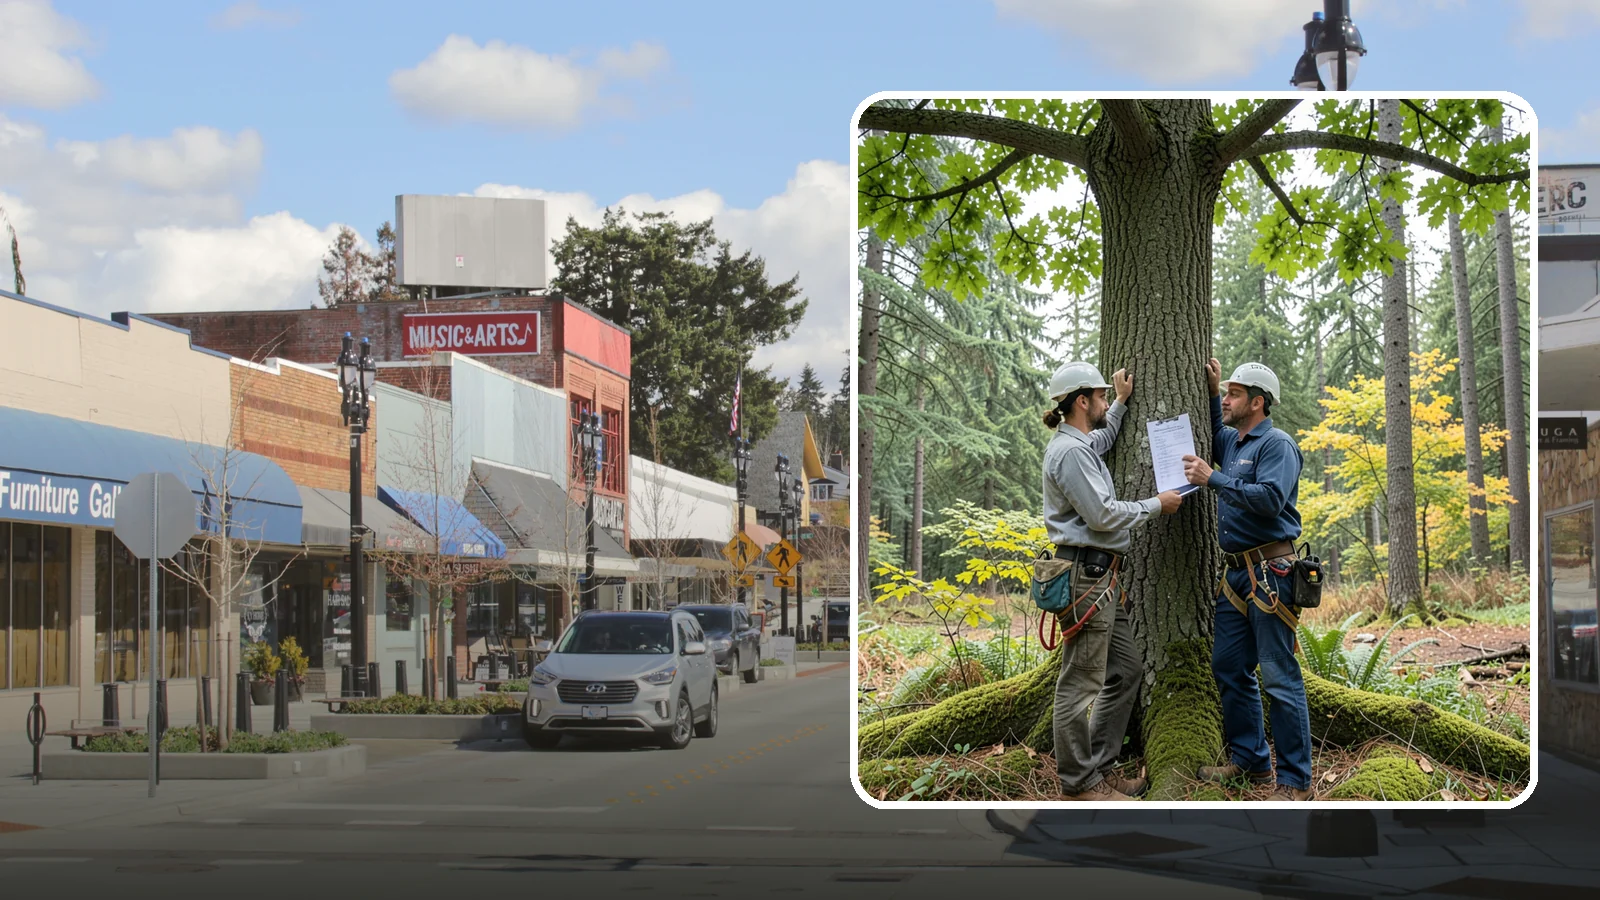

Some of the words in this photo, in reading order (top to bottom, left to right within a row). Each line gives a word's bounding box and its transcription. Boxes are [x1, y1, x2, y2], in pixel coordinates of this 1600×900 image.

[0, 471, 79, 515] Furniture
[90, 483, 121, 519] Gal
[453, 563, 479, 574] SUSHI
